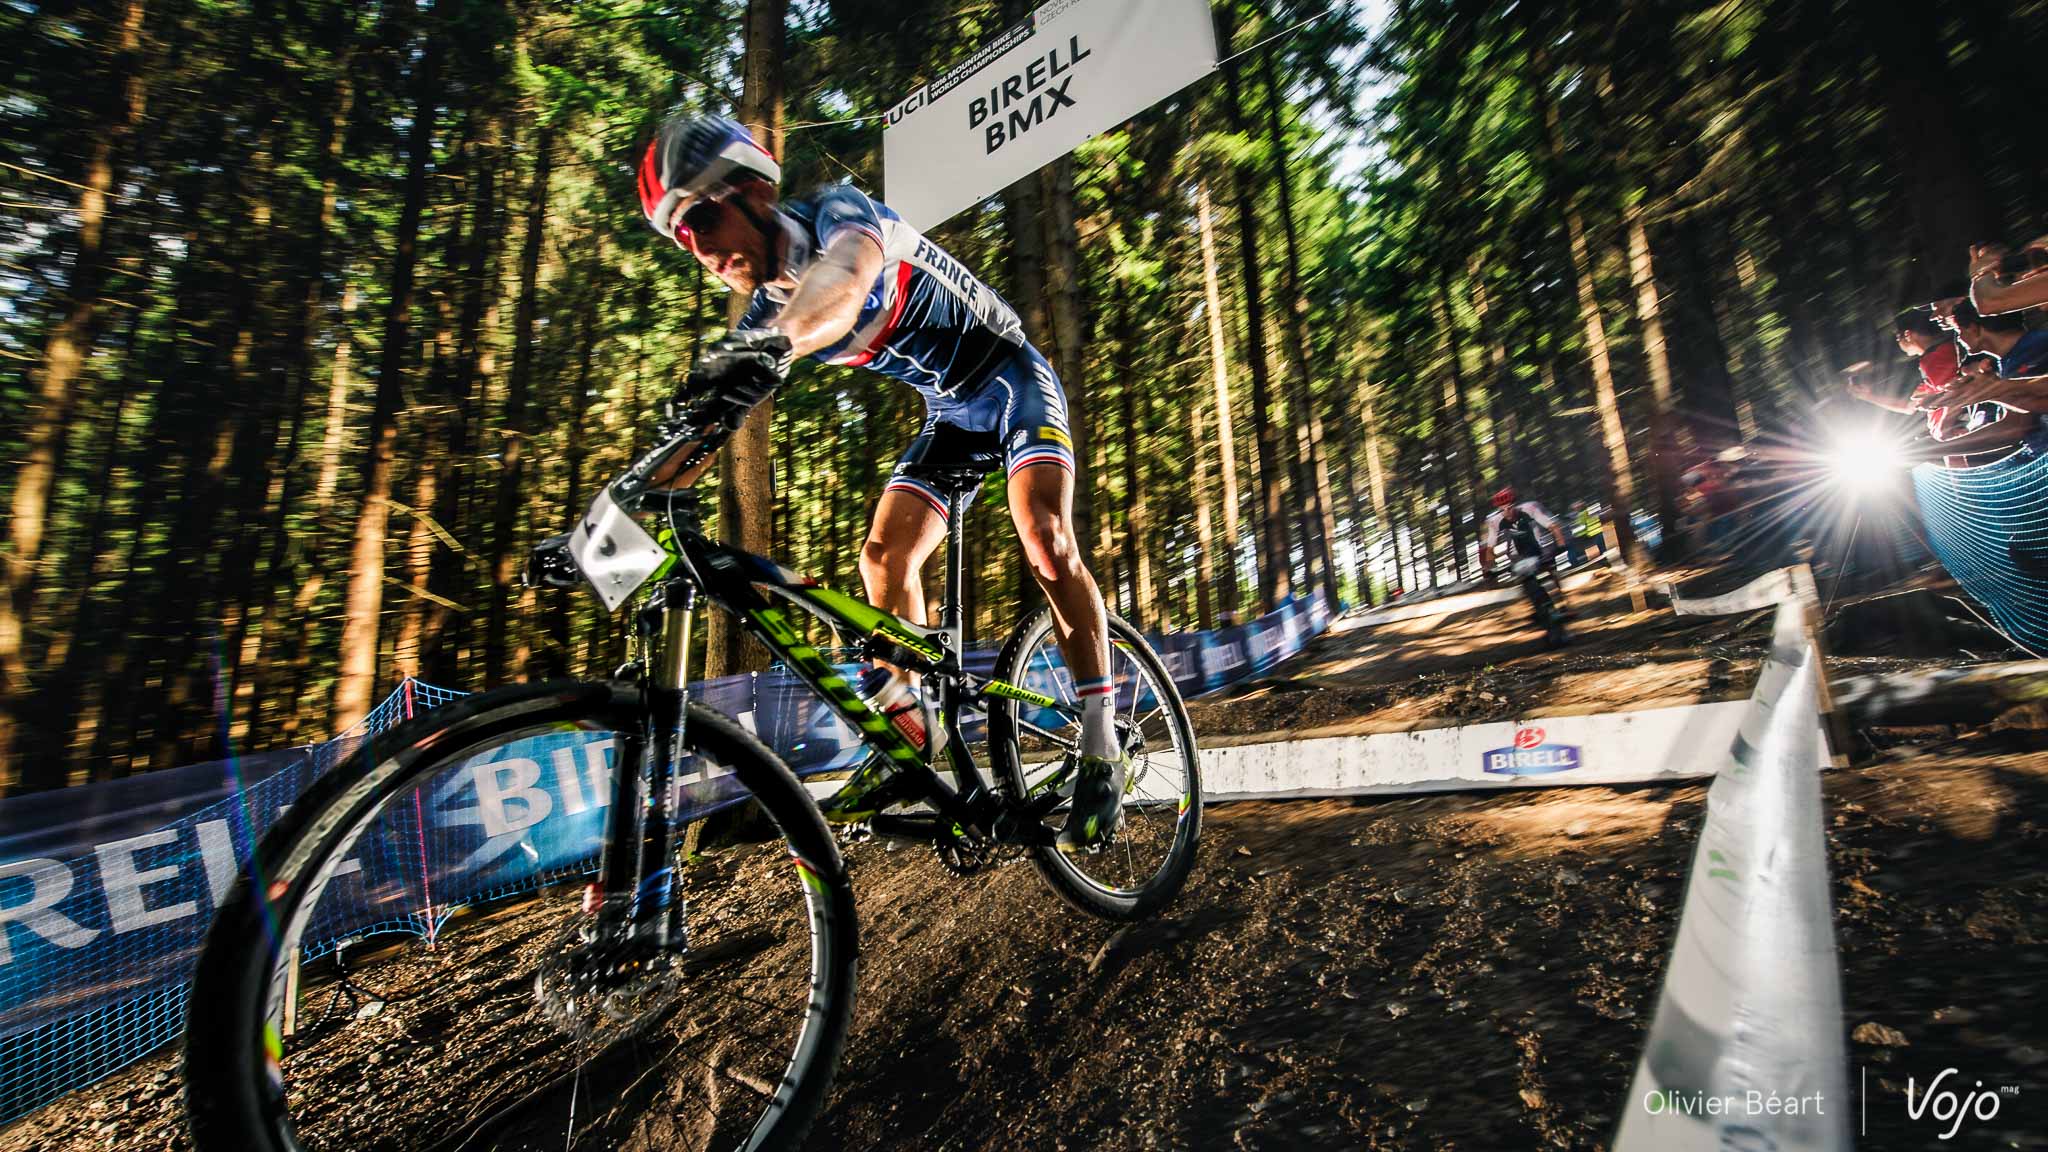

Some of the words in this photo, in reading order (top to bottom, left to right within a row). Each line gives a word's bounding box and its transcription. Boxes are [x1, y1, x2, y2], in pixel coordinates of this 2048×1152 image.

[930, 76, 947, 92] 2016
[948, 45, 991, 79] MOUNTAIN
[993, 31, 1011, 50] BIKE
[931, 75, 959, 99] WORLD
[961, 29, 1030, 79] CHAMPIONSHIPS
[969, 35, 1091, 130] BIRELL
[888, 92, 924, 125] UCI
[985, 74, 1076, 155] BMX
[914, 240, 979, 302] FRANCE
[1490, 748, 1578, 770] BIRELL
